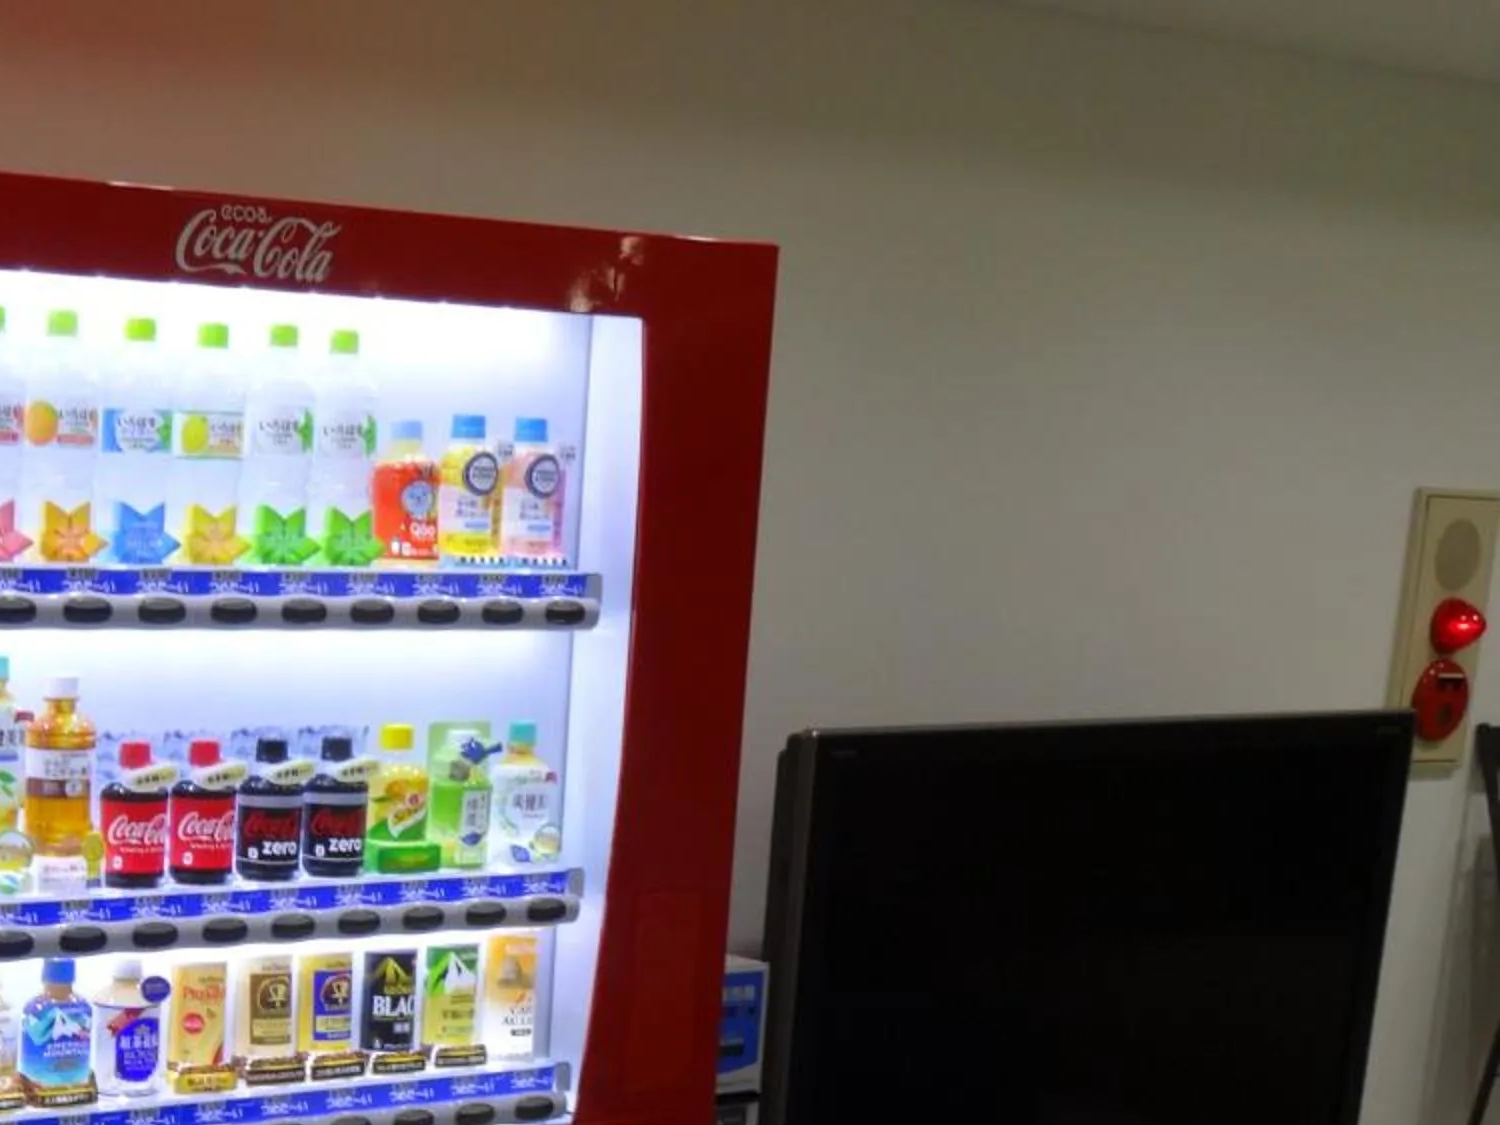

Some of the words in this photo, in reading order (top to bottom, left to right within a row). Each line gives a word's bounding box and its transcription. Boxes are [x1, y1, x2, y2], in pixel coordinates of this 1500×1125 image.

[175, 209, 341, 282] Coca-Cola
[262, 840, 297, 856] zero
[328, 837, 362, 852] zero
